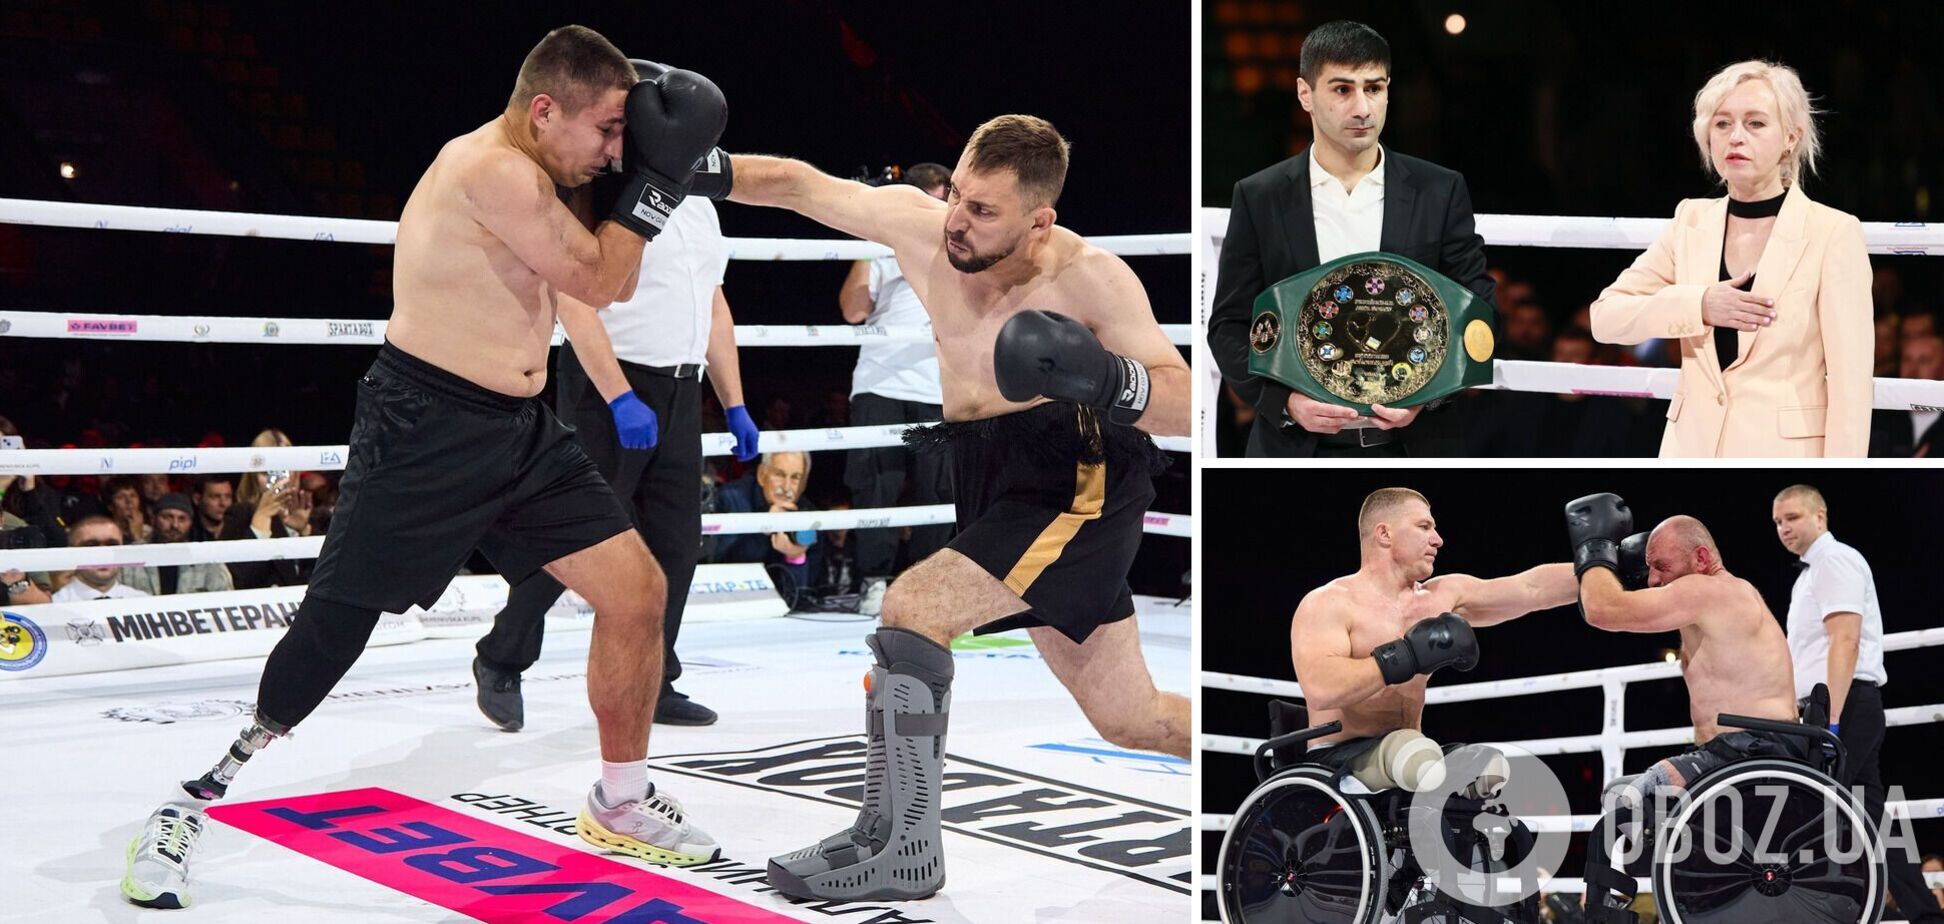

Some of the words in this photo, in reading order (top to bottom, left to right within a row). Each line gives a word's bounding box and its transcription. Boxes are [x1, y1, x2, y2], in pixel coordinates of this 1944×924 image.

[84, 322, 133, 330] FAVBET
[169, 456, 197, 470] pipl
[106, 600, 301, 643] МІНВЕТЕРАН
